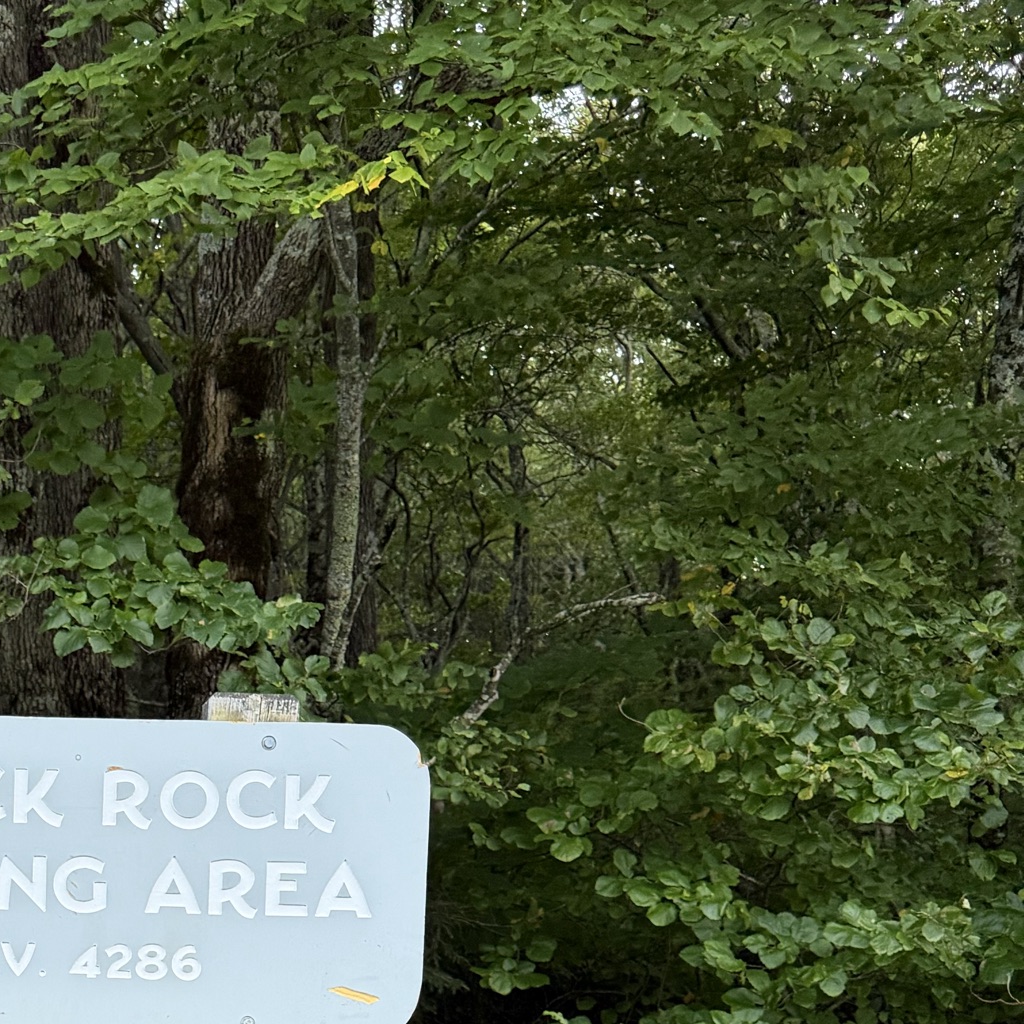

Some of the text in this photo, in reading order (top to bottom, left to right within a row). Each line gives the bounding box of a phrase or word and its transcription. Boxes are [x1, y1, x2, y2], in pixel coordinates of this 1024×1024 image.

[102, 769, 337, 834] ROCK
[144, 857, 373, 920] AREA
[67, 943, 203, 983] 4286
